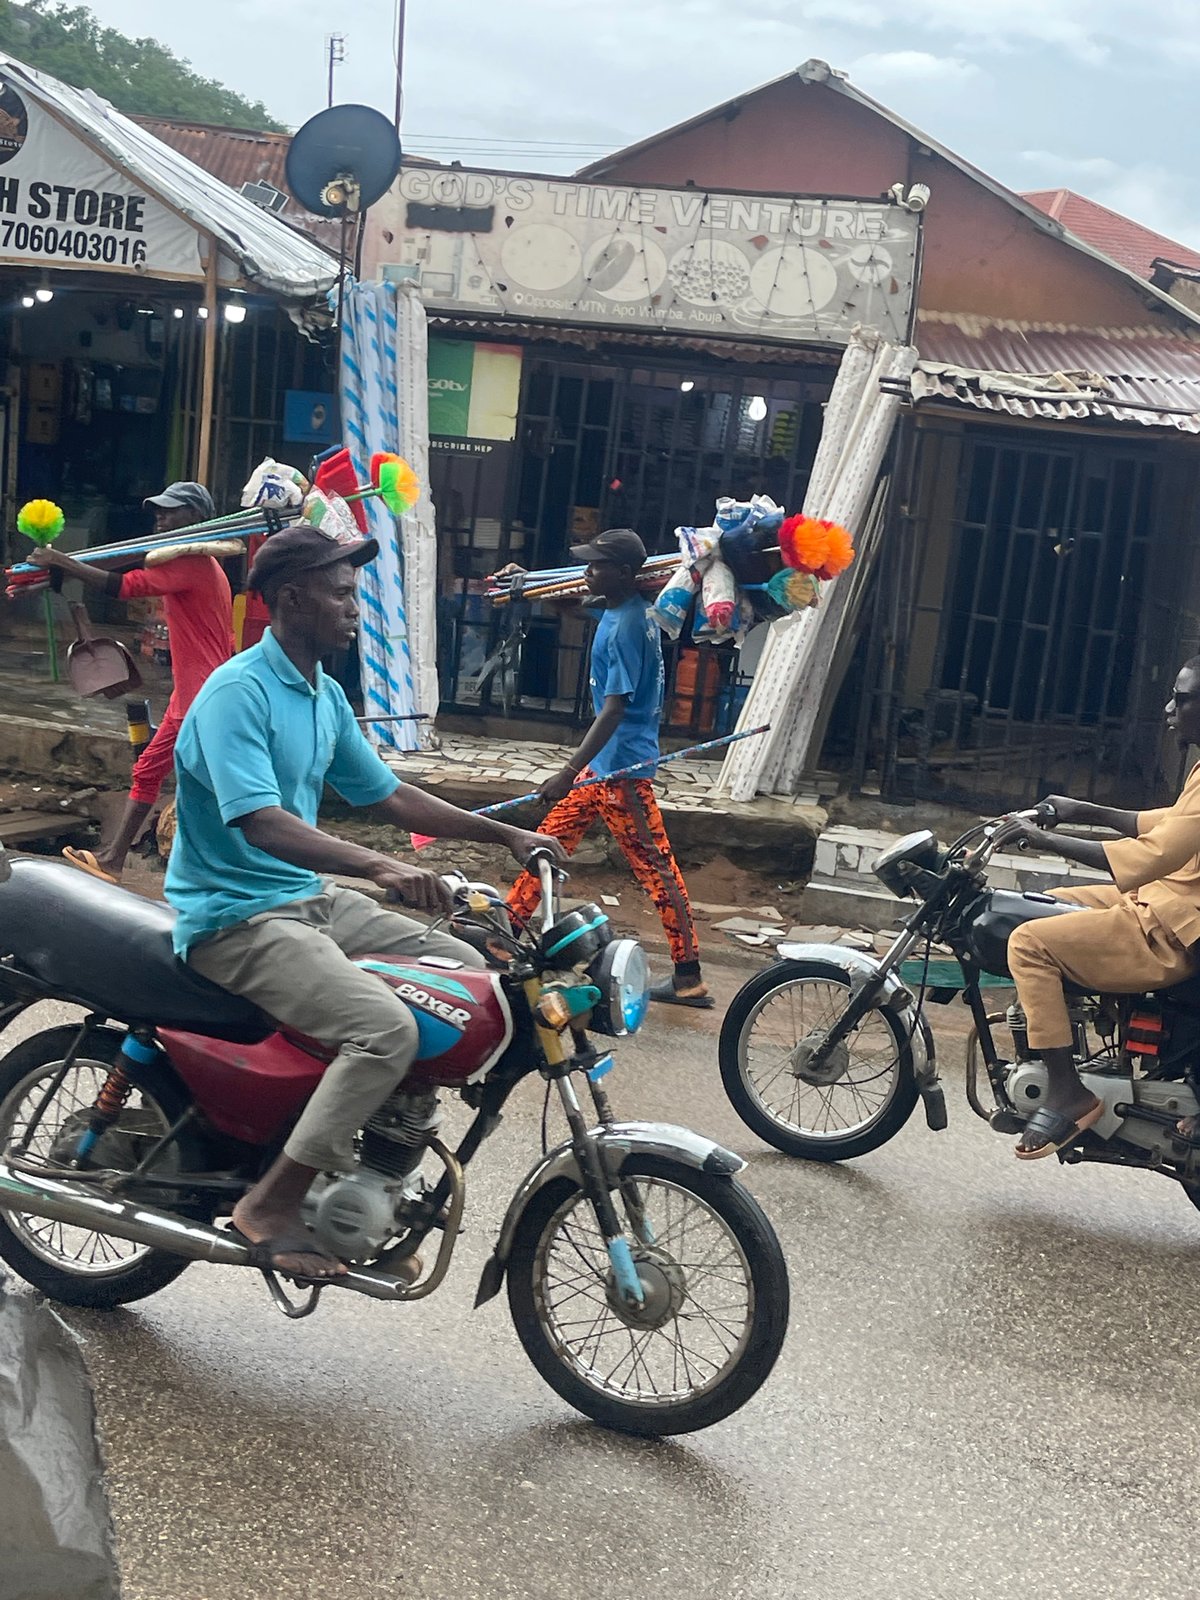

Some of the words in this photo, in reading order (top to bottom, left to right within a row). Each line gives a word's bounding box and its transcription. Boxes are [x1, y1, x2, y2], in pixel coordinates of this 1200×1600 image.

[28, 182, 146, 232] STORE
[399, 170, 534, 211] GOD'S
[547, 183, 658, 224] TIME
[671, 196, 884, 241] VENTURE
[2, 220, 147, 264] 7060403016
[612, 304, 635, 318] Apo
[689, 311, 723, 325] Abuja
[395, 983, 472, 1029] BOXER
